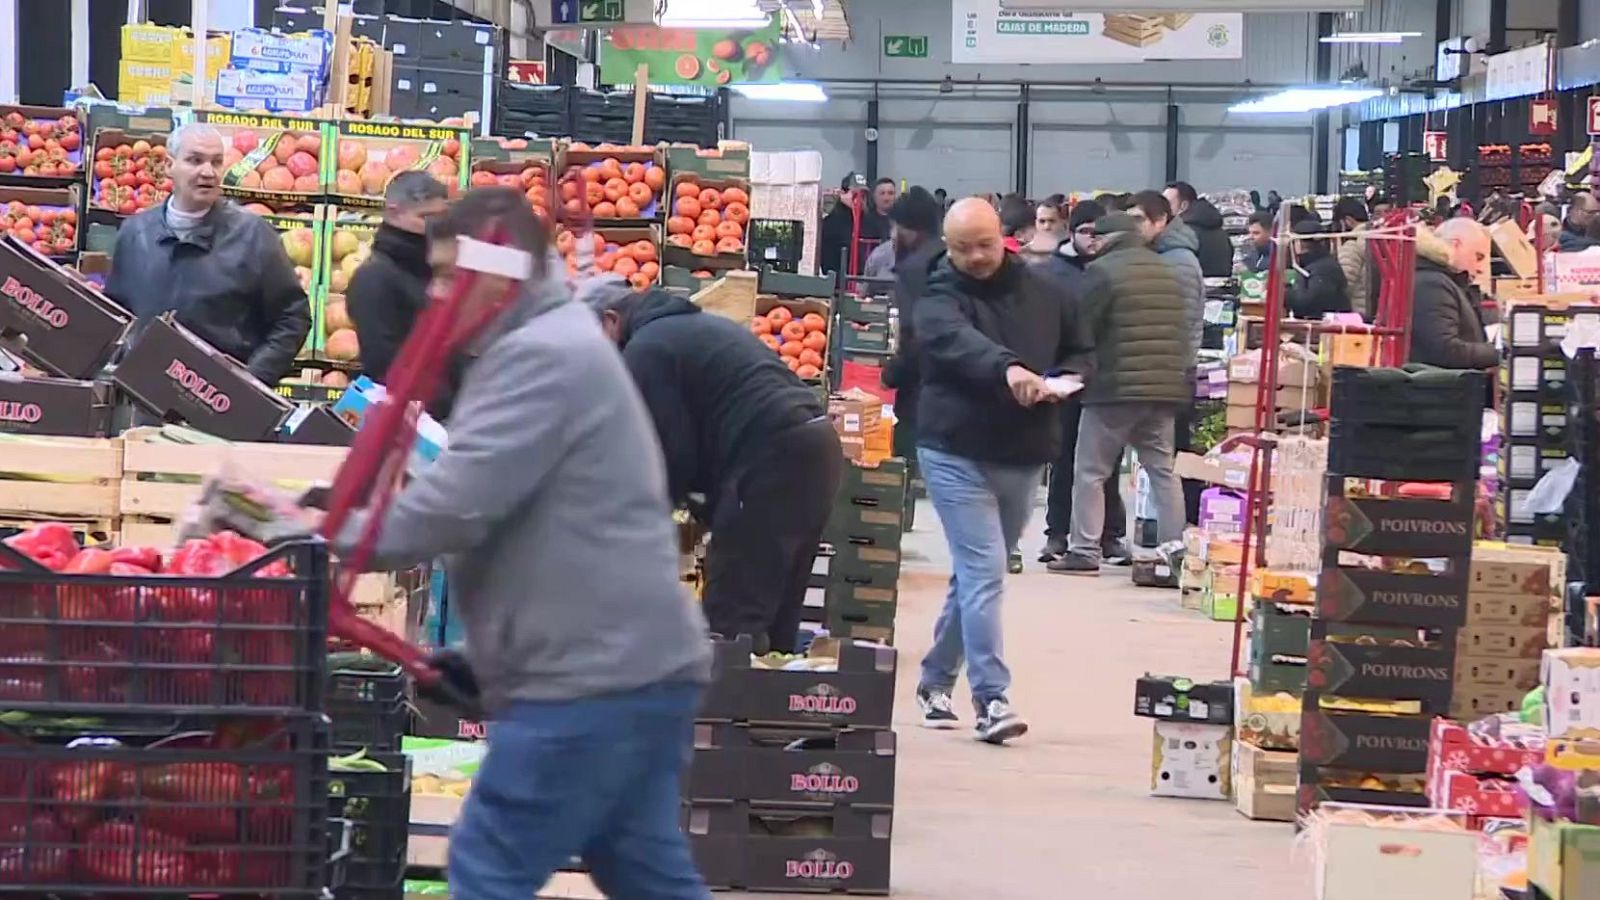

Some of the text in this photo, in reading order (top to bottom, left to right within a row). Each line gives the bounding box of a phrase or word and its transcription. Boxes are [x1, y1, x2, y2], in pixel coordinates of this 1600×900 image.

[998, 22, 1087, 33] CAJAS DE MADERA
[207, 113, 314, 131] ROSADO DEL SUR
[348, 123, 455, 139] ROSADO DEL SUR
[1, 276, 69, 328] BOLLO
[165, 359, 231, 412] BOLLO
[0, 401, 42, 423] LLO
[1381, 519, 1467, 534] POIVRONS
[1372, 590, 1459, 608] POIVRONS
[1362, 663, 1449, 680] POIVRONS
[788, 694, 857, 714] BOLLO
[790, 773, 859, 793] BOLLO
[785, 860, 854, 879] BOLLO
